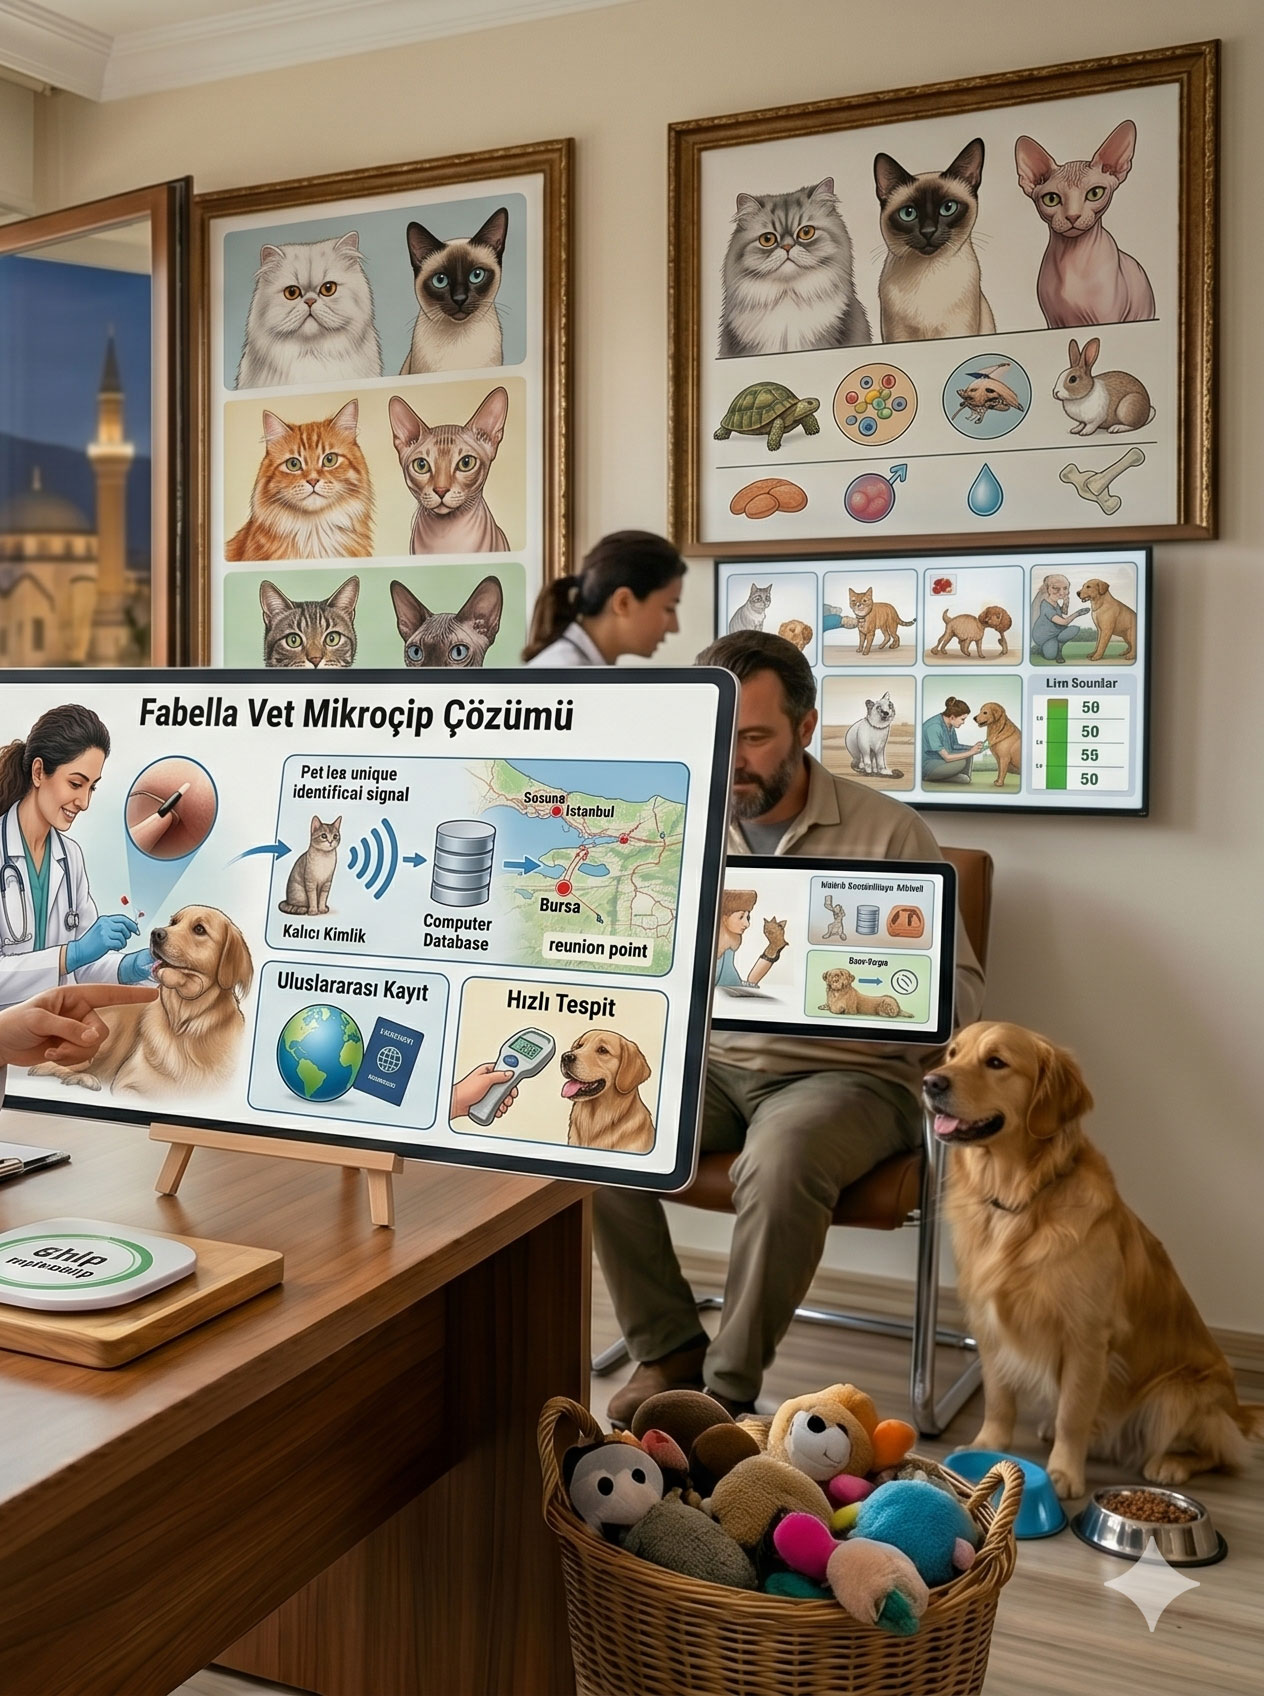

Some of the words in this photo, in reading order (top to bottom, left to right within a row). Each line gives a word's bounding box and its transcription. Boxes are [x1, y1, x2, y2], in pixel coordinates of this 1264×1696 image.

[139, 696, 238, 728] Fabella
[248, 698, 295, 728] Vet
[303, 697, 434, 738] Mikroçip
[443, 698, 575, 739] Çözümü
[1081, 725, 1100, 738] 50
[301, 764, 324, 779] Pet
[351, 766, 398, 784] unique
[1080, 773, 1099, 786] 50
[367, 785, 410, 805] signal
[566, 804, 615, 818] Istanbul
[539, 897, 581, 914] Bursa
[423, 913, 493, 932] Computer
[282, 924, 320, 940] Kalıcı
[324, 926, 367, 944] Kimlik
[423, 932, 489, 951] Database
[549, 938, 605, 956] reunion
[609, 941, 648, 960] point
[277, 971, 379, 997] Uluslararası
[383, 980, 430, 1005] Kayıt
[507, 989, 550, 1012] Hızlı
[555, 992, 617, 1021] Tespit
